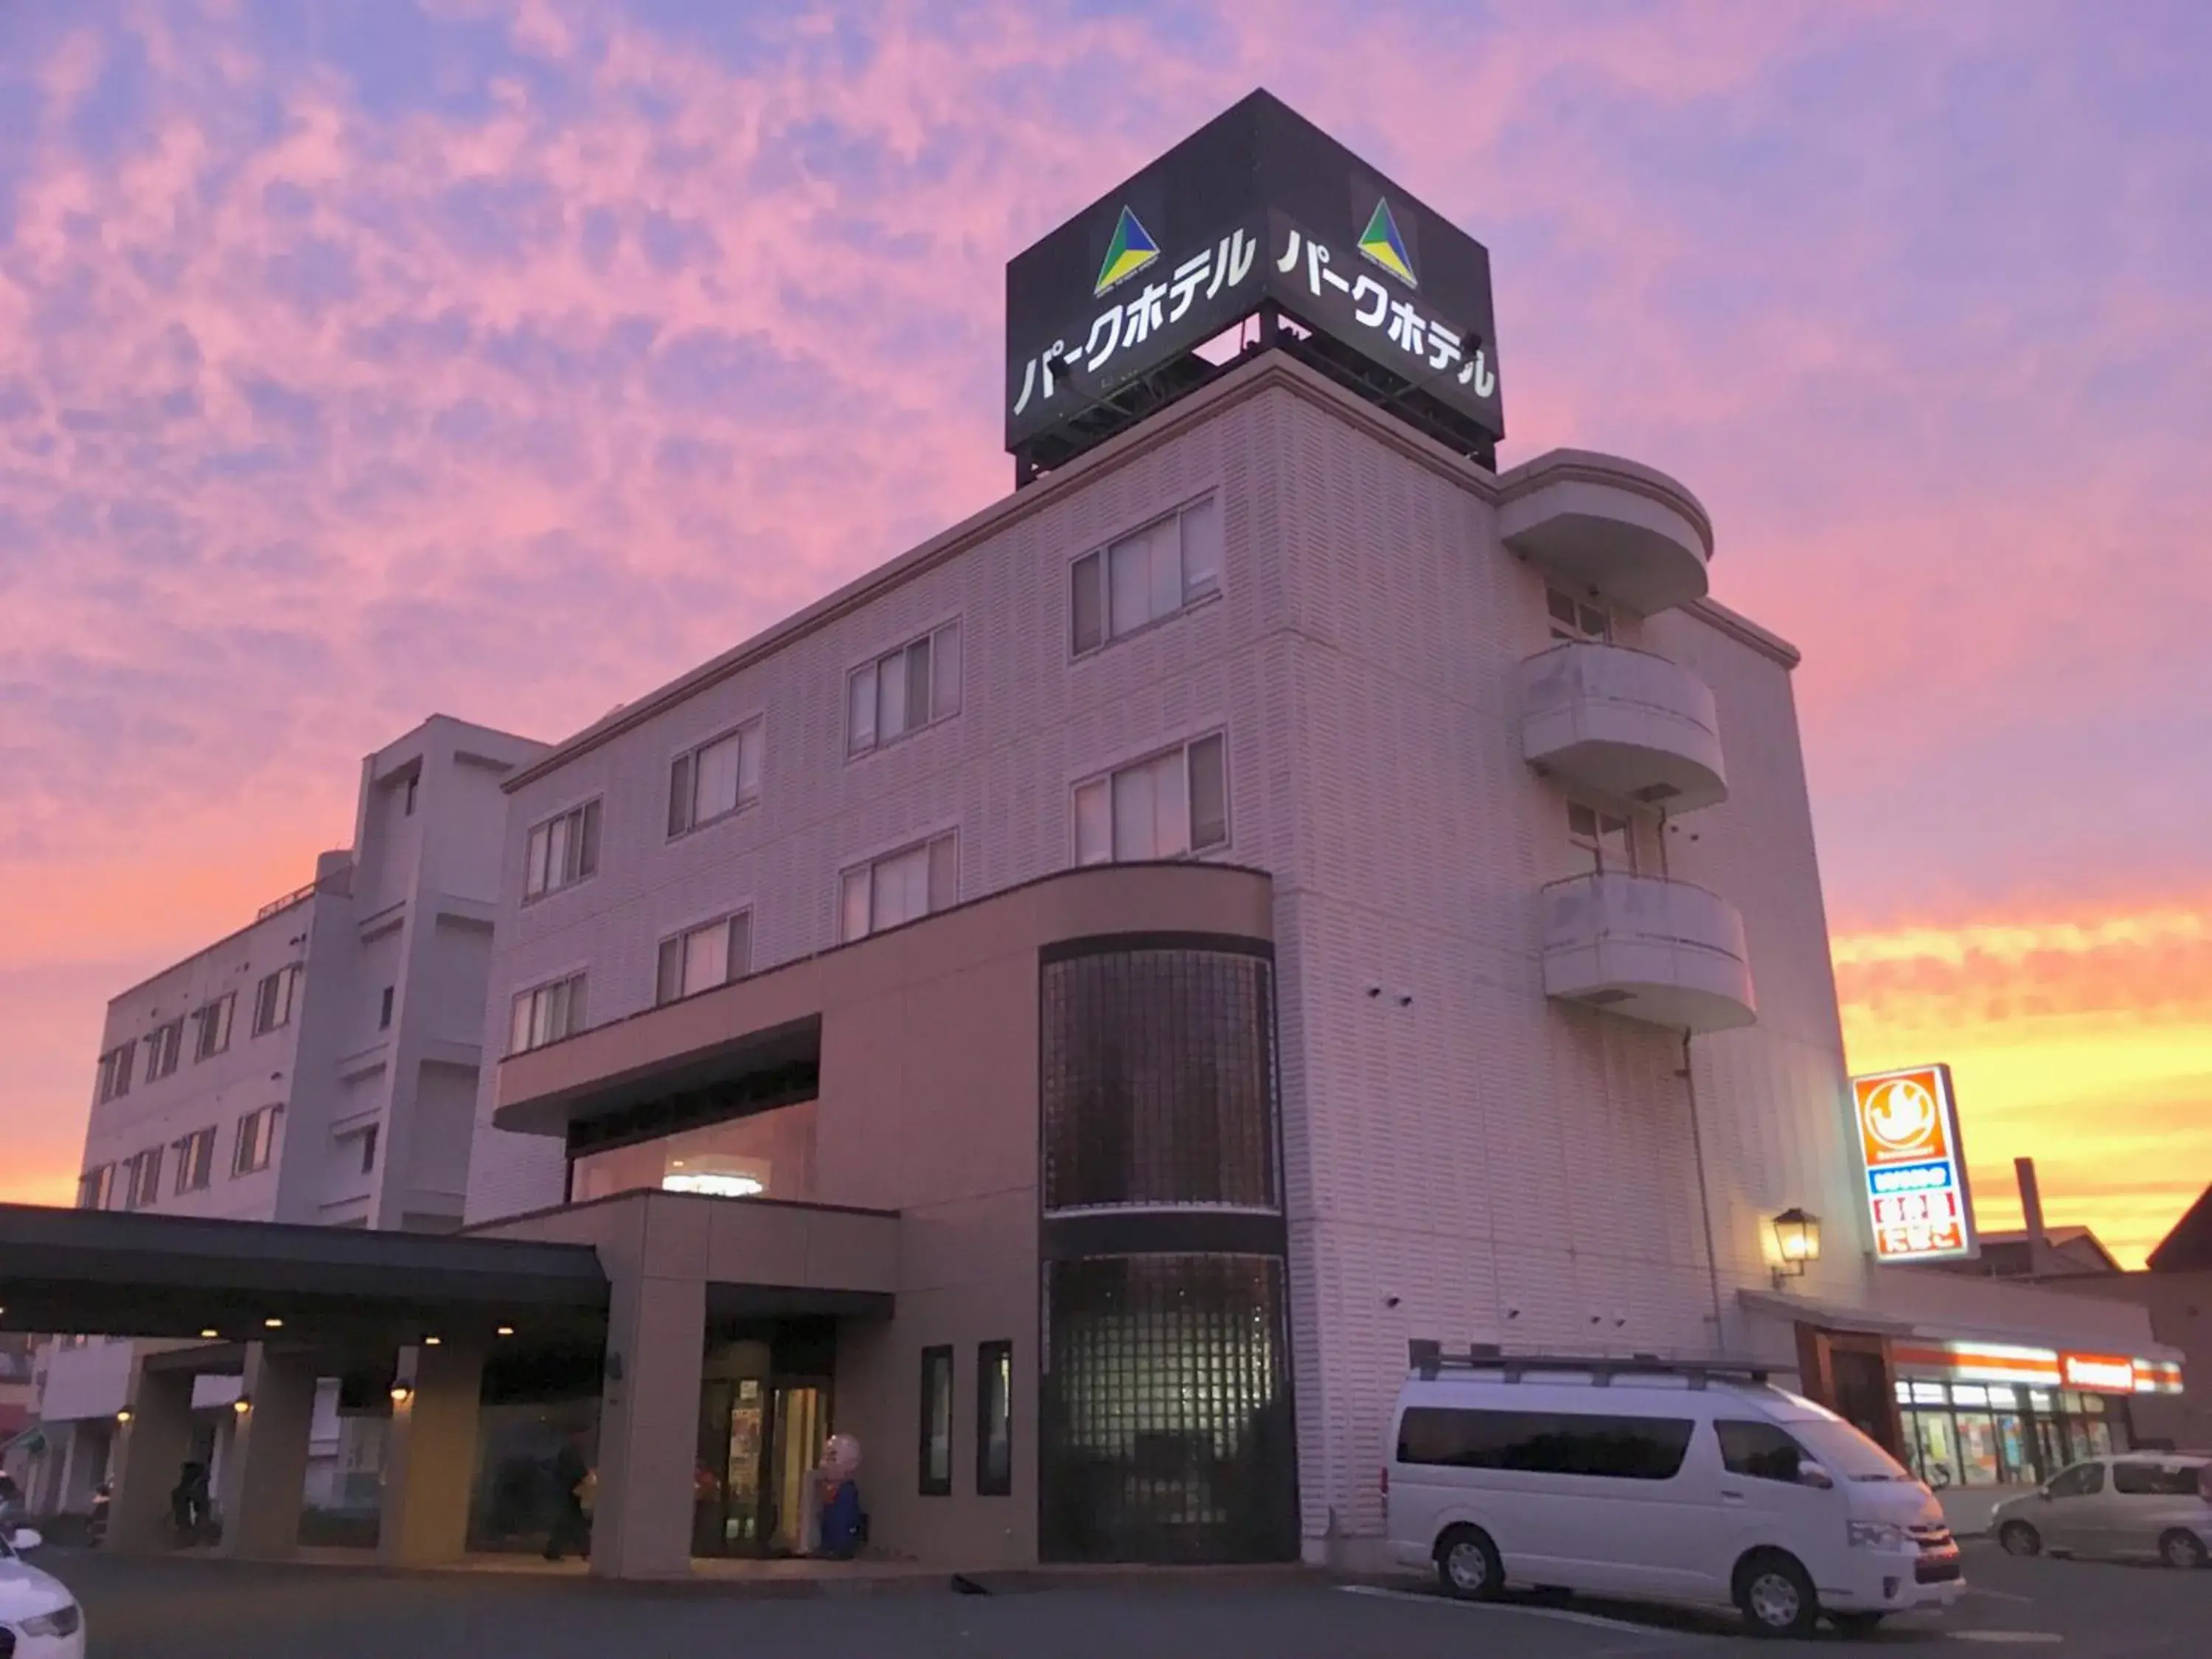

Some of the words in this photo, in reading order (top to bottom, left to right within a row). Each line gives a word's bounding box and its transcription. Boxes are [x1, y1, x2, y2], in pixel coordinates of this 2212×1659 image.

[1014, 228, 1256, 416] パークホテル
[1276, 229, 1495, 398] パークホテル
